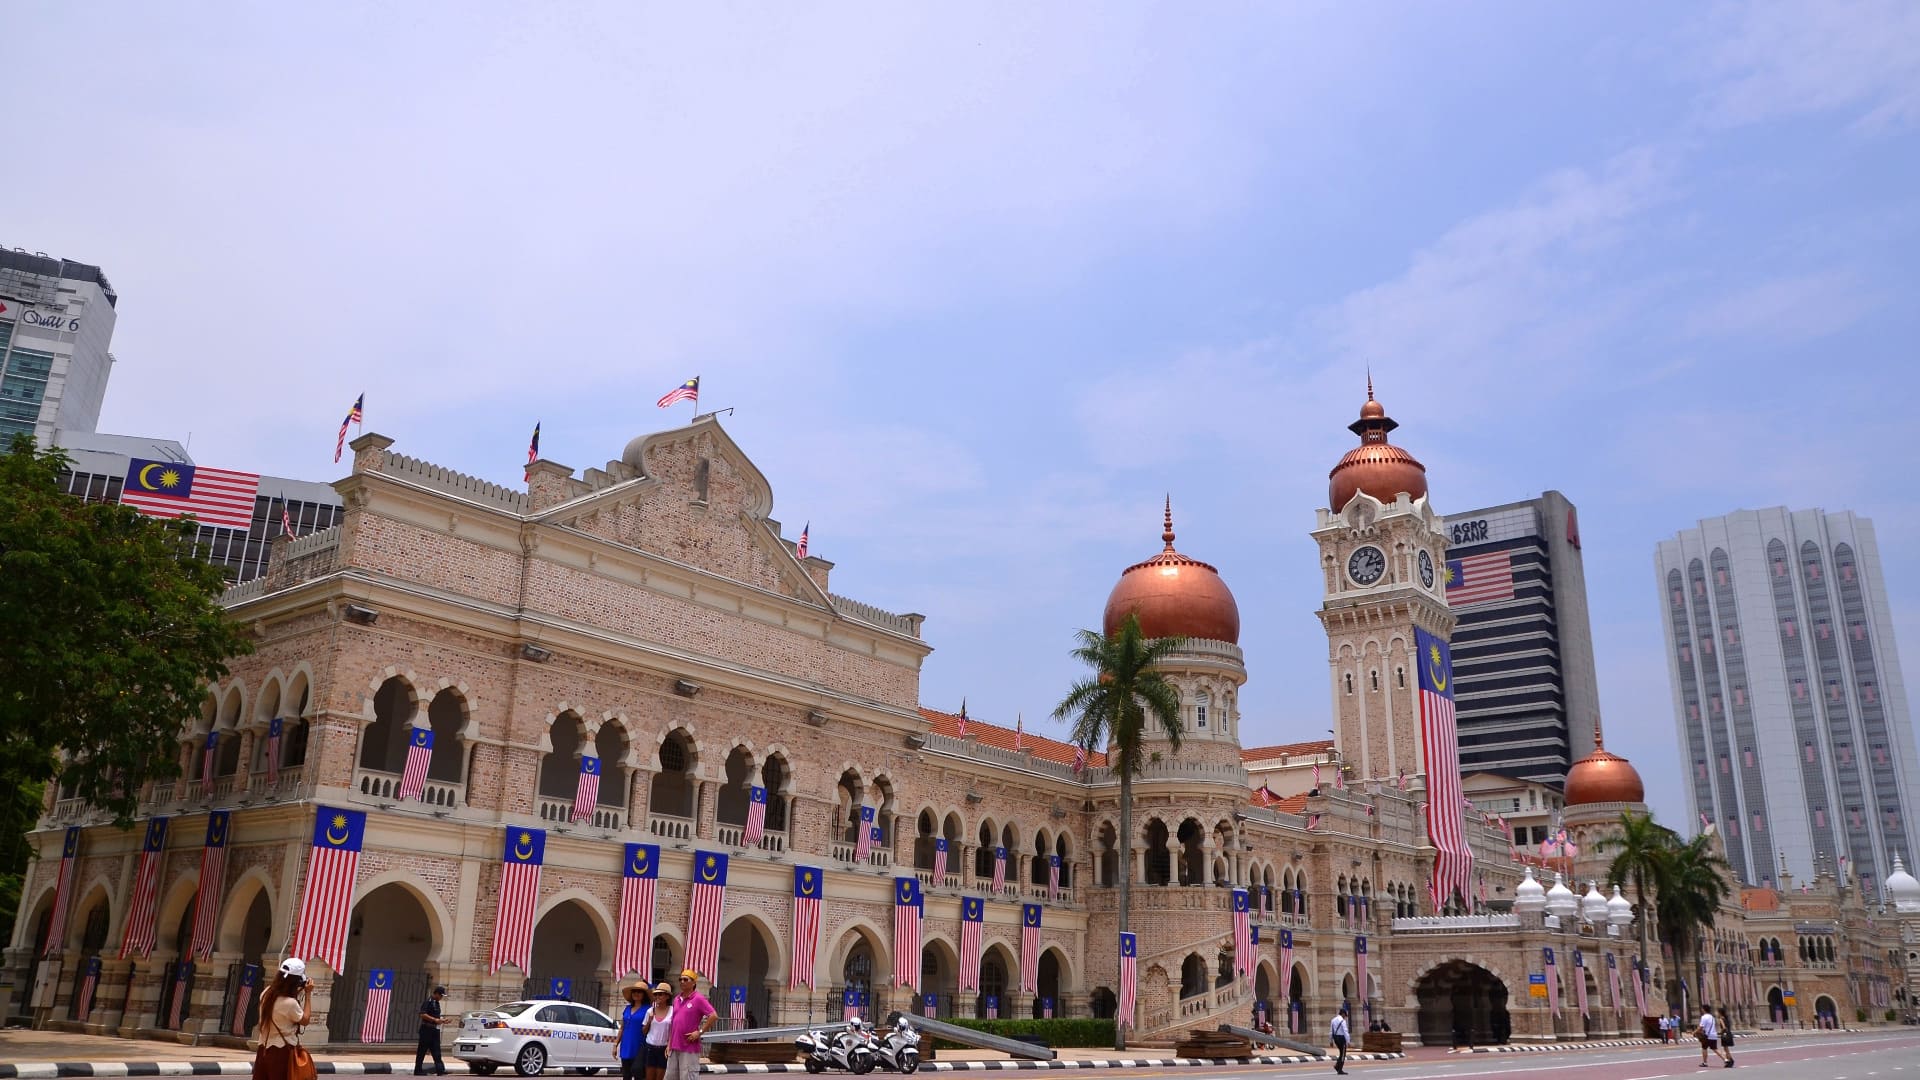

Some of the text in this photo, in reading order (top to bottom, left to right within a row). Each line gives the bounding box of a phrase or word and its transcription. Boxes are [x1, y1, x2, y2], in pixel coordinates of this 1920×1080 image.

[24, 310, 80, 331] Quill 6
[1453, 519, 1488, 535] AGRO
[1454, 529, 1489, 545] BANK
[552, 1030, 577, 1040] POLIS
